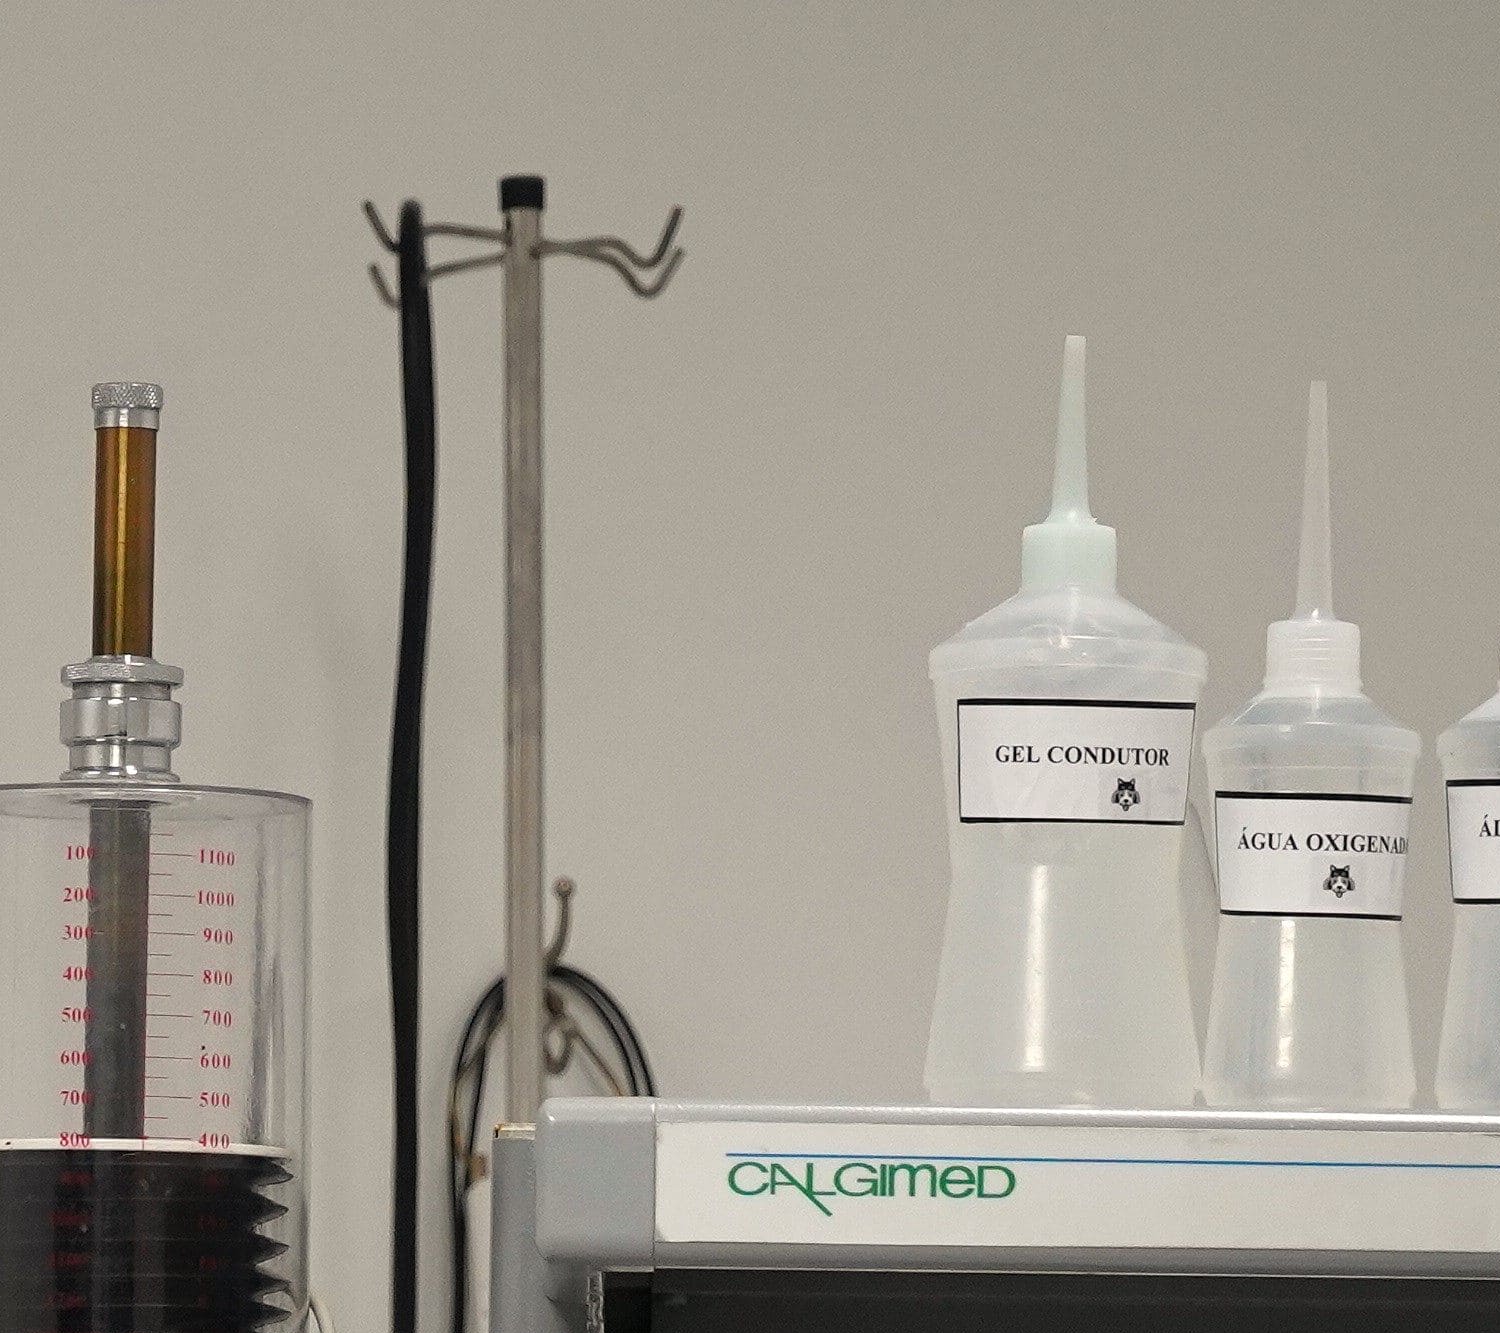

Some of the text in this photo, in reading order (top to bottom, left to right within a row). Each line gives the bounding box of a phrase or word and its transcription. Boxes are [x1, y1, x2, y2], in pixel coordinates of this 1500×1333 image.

[995, 745, 1170, 768] GEL CONDUTOR
[1238, 828, 1408, 855] ÁGUA OXIGENAD
[199, 850, 235, 866] 1100
[198, 891, 234, 906] 1000
[203, 930, 233, 945] 900
[63, 967, 92, 981] 400
[203, 971, 232, 986] 800
[62, 1008, 90, 1022] 500
[203, 1011, 232, 1027] 700
[61, 1051, 90, 1065] 600
[201, 1054, 231, 1069] 600
[60, 1091, 90, 1105] 700
[200, 1093, 230, 1107] 500
[60, 1133, 90, 1147] 800
[199, 1134, 229, 1148] 400
